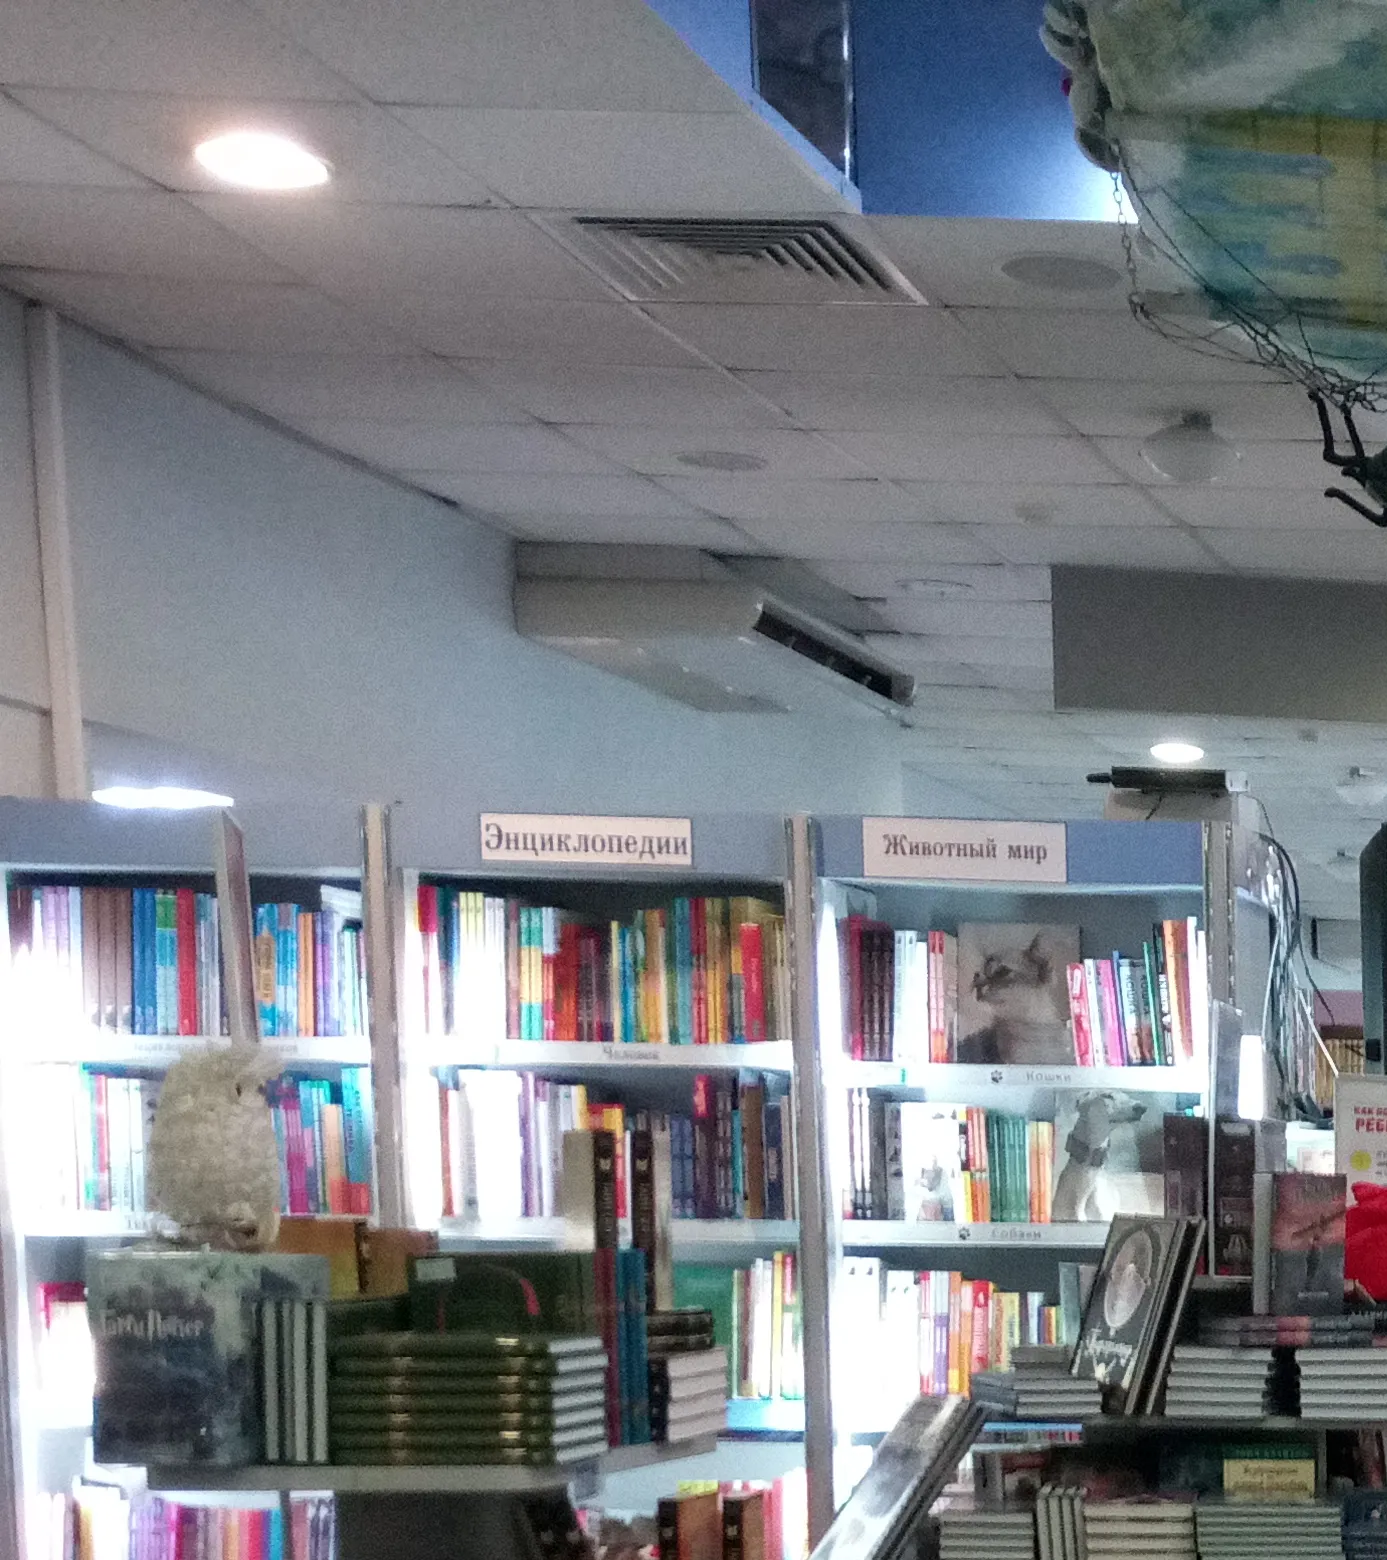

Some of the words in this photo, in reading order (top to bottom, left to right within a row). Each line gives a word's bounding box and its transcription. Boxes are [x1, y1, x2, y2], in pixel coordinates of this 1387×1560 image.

[484, 822, 689, 858] Энциклопедии
[883, 832, 997, 860] Животный
[1007, 842, 1048, 863] мир
[1025, 1069, 1072, 1085] Кошки
[1354, 1105, 1374, 1117] КАК
